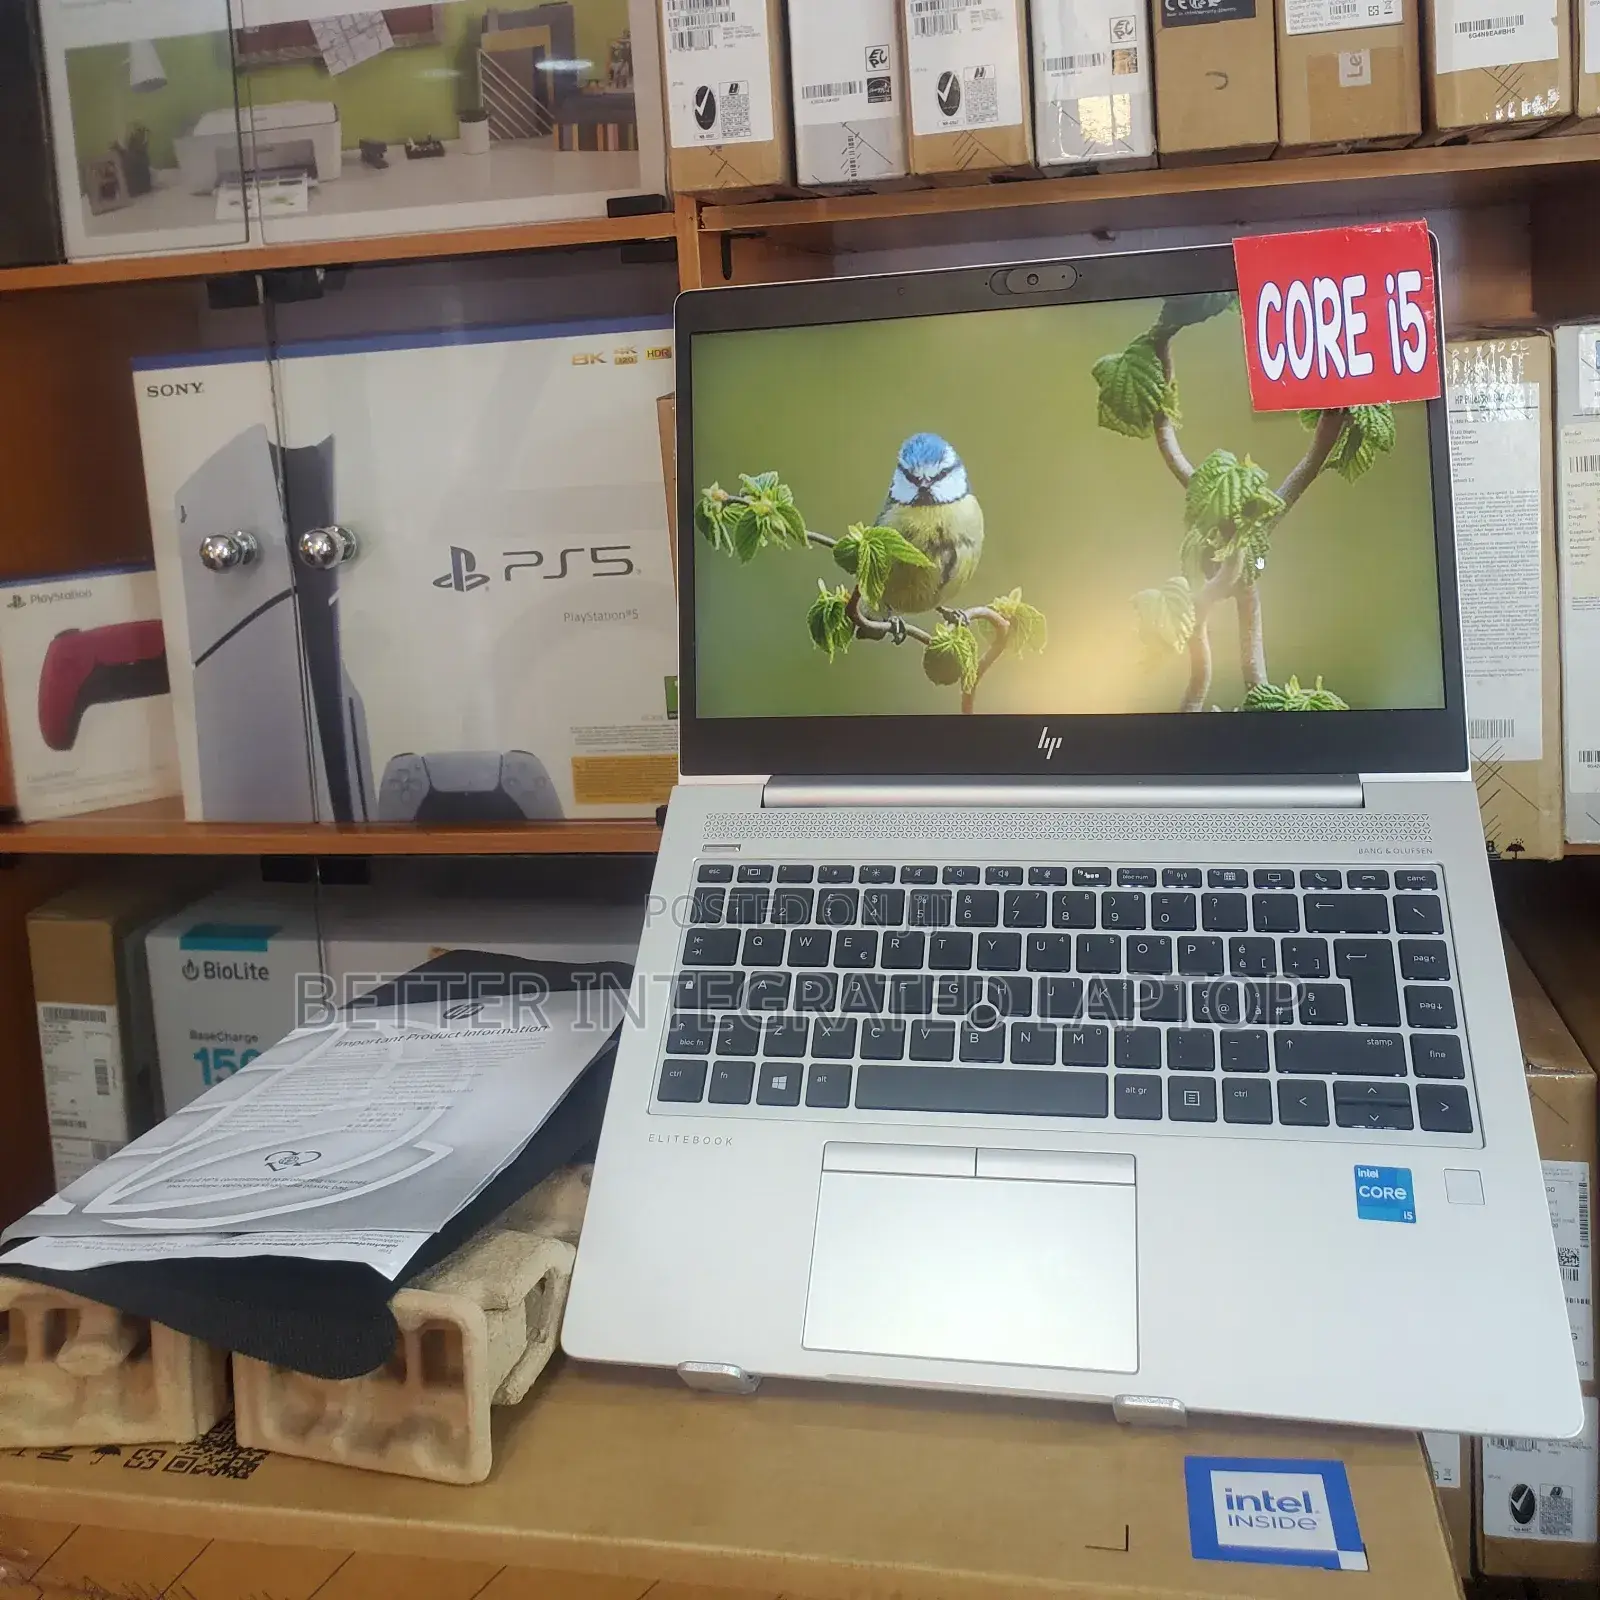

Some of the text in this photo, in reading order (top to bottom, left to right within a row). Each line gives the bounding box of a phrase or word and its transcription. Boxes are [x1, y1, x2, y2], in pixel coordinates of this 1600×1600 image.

[1257, 269, 1428, 382] CORE i5
[646, 348, 672, 358] HDR
[146, 381, 205, 398] SONY
[502, 545, 634, 581] PS5
[30, 588, 92, 604] PlayStation
[1358, 847, 1433, 855] BANG & OLUFSEN
[752, 936, 763, 946] Q
[799, 936, 813, 947] W
[844, 937, 852, 947] E
[891, 938, 900, 949] R
[938, 939, 947, 949] T
[987, 940, 997, 950] Y
[1036, 941, 1046, 951] U
[1137, 943, 1148, 954] O
[1187, 944, 1197, 955] P
[203, 961, 270, 981] BioLite
[757, 979, 768, 990] A
[804, 980, 813, 991] S
[851, 982, 861, 992] D
[899, 982, 907, 992] F
[948, 983, 959, 993] G
[997, 984, 1007, 995] H
[1047, 986, 1055, 996] J
[1099, 987, 1109, 998] K
[1150, 989, 1158, 1000] L
[773, 1025, 783, 1036] Z
[822, 1026, 832, 1037] X
[870, 1027, 881, 1038] C
[920, 1029, 931, 1039] V
[189, 1029, 259, 1045] BaseCharge
[335, 1025, 548, 1048] Important Product Information
[970, 1033, 979, 1043] B
[1020, 1032, 1031, 1042] N
[1073, 1033, 1084, 1045] M
[1366, 1038, 1393, 1047] stamp
[1429, 1050, 1446, 1058] fine
[720, 1071, 728, 1079] fn
[816, 1075, 827, 1083] alt
[1125, 1086, 1148, 1096] alt gr
[648, 1133, 733, 1146] ELITEBOOK
[1357, 1167, 1379, 1179] intel
